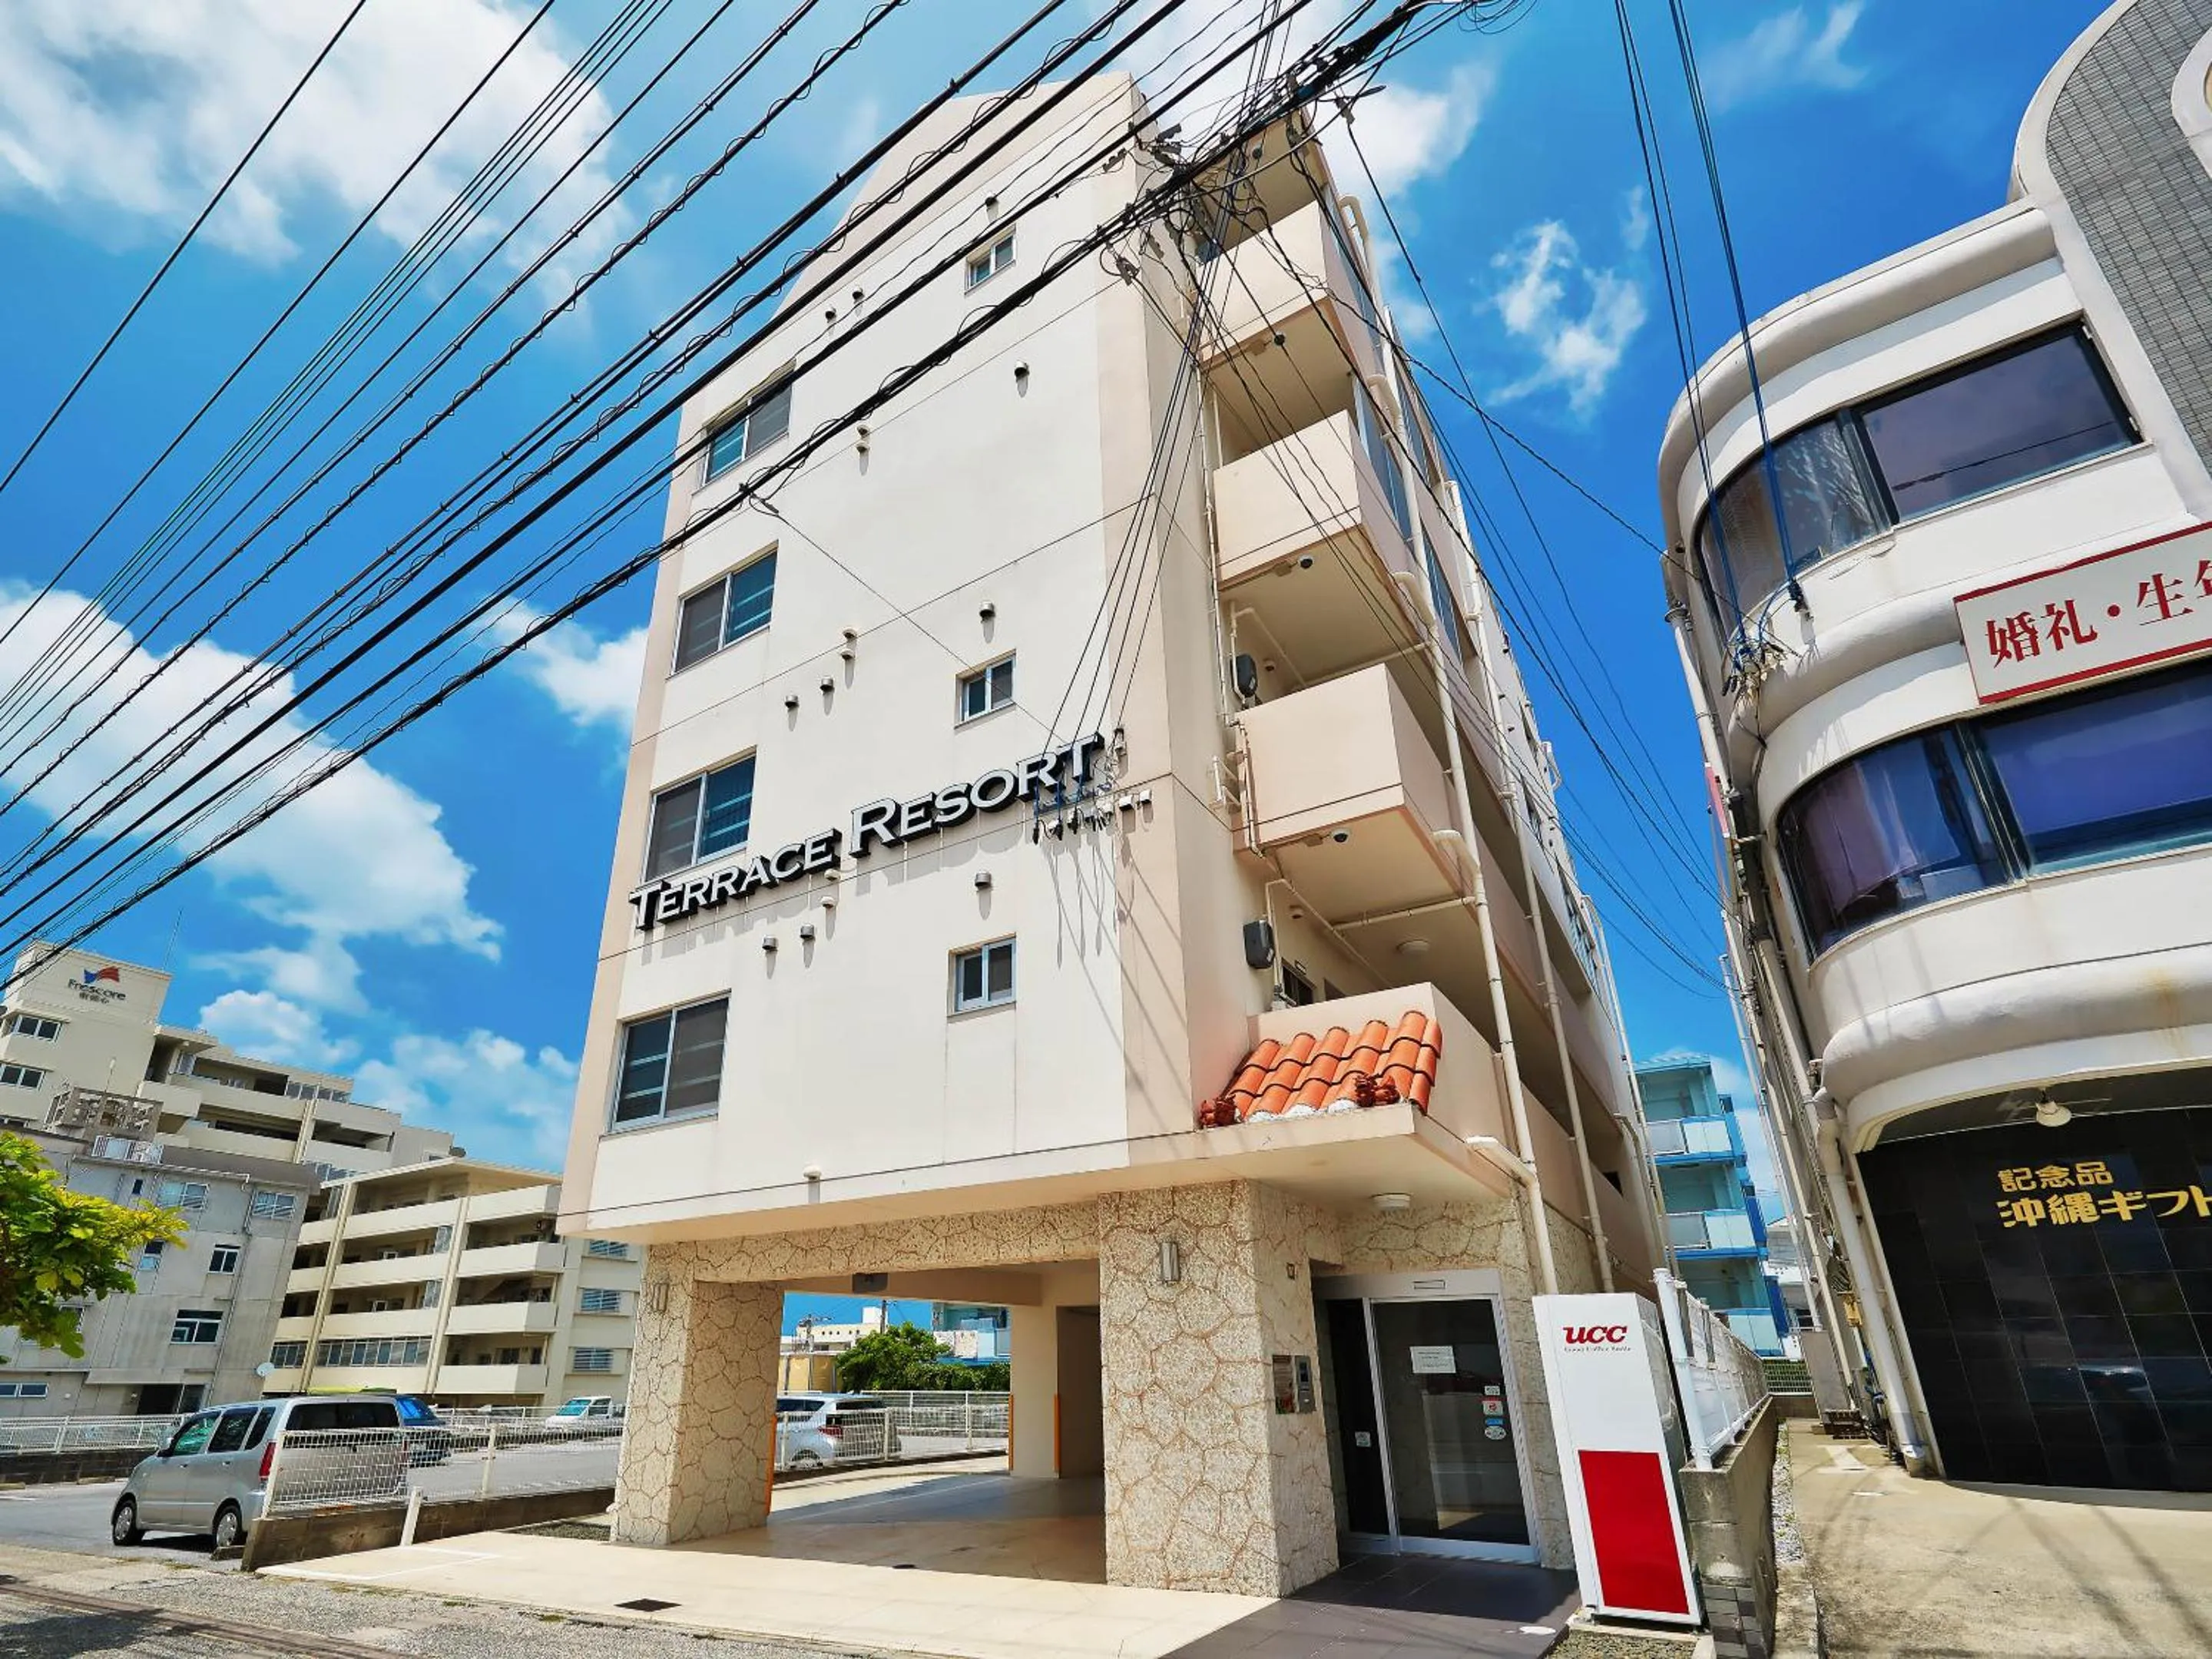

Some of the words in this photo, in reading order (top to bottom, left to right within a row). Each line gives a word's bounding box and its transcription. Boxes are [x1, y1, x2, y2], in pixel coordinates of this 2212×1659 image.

[629, 829, 843, 931] TERRACE
[849, 732, 1106, 859] RESORT
[1998, 1161, 2114, 1193] 記念品
